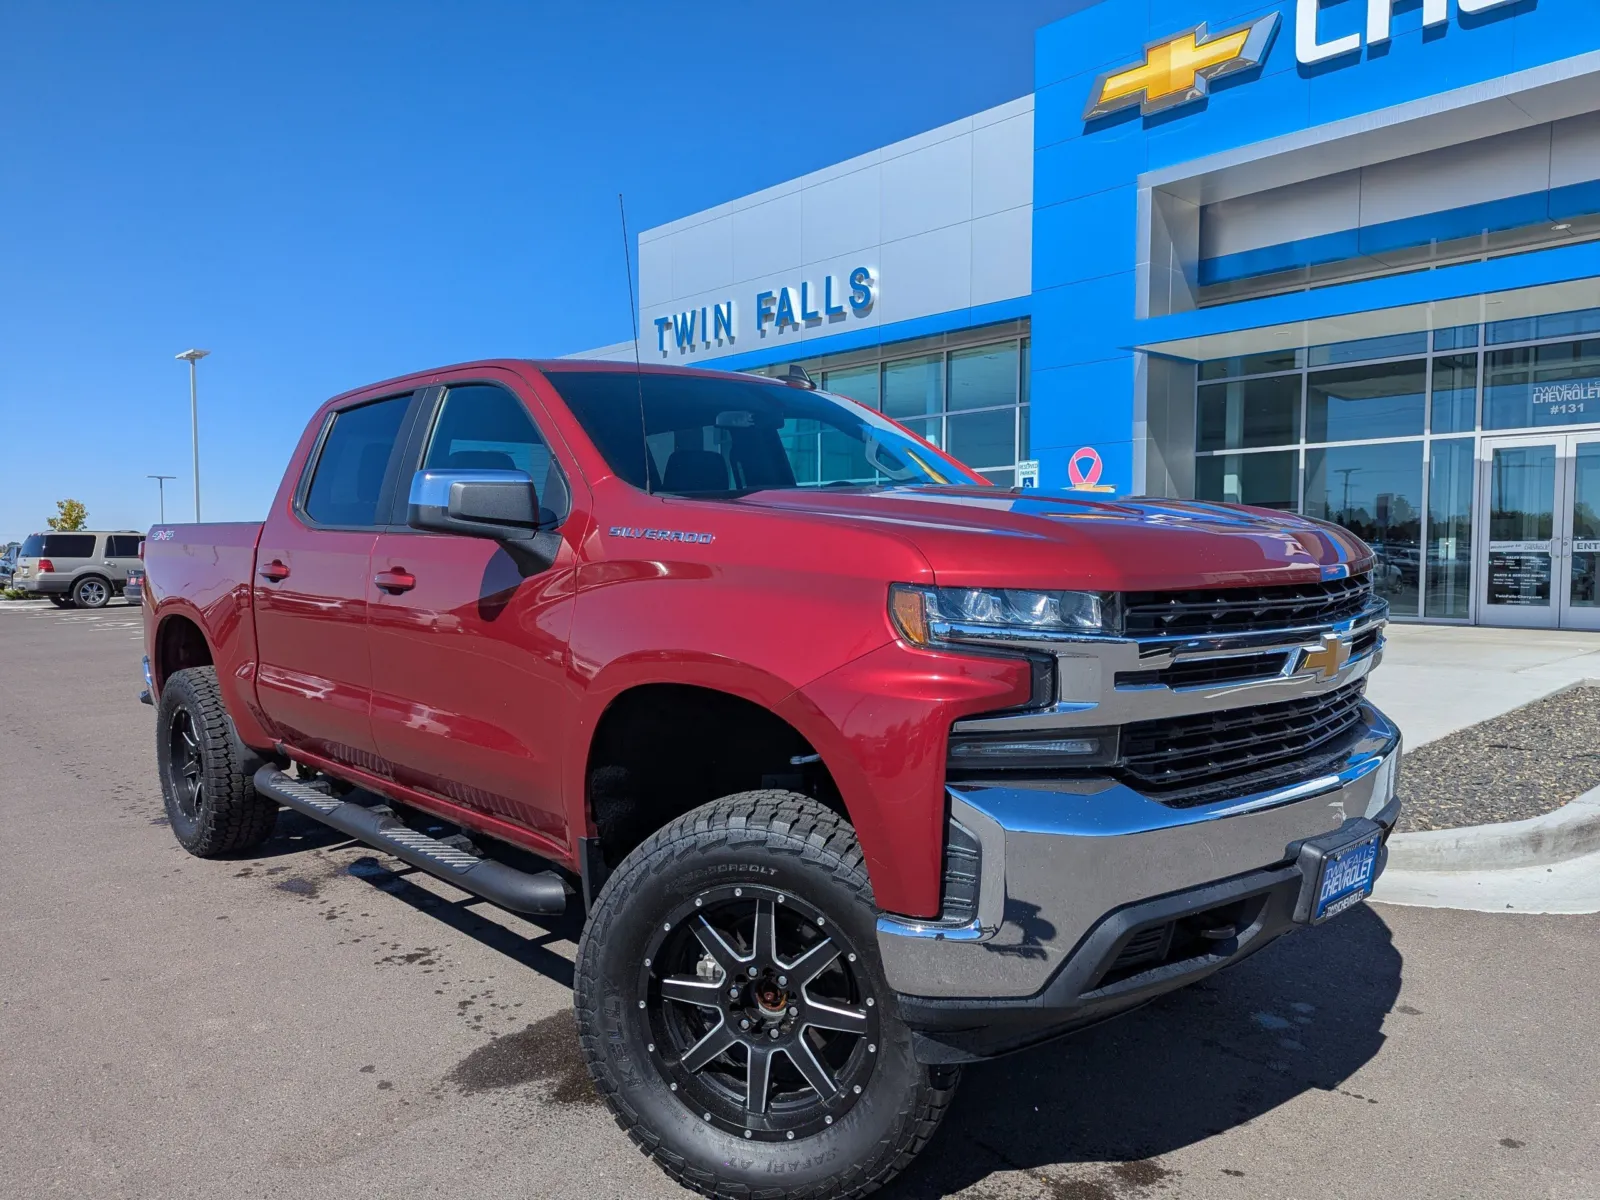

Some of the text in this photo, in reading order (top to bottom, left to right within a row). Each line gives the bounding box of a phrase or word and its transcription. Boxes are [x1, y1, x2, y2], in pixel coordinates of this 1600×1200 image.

[654, 266, 873, 352] TWIN FALLS
[1550, 403, 1584, 415] #131
[1019, 462, 1038, 470] RESERVED
[608, 526, 713, 545] SILVERADO
[1320, 858, 1374, 901] CHEVROLET
